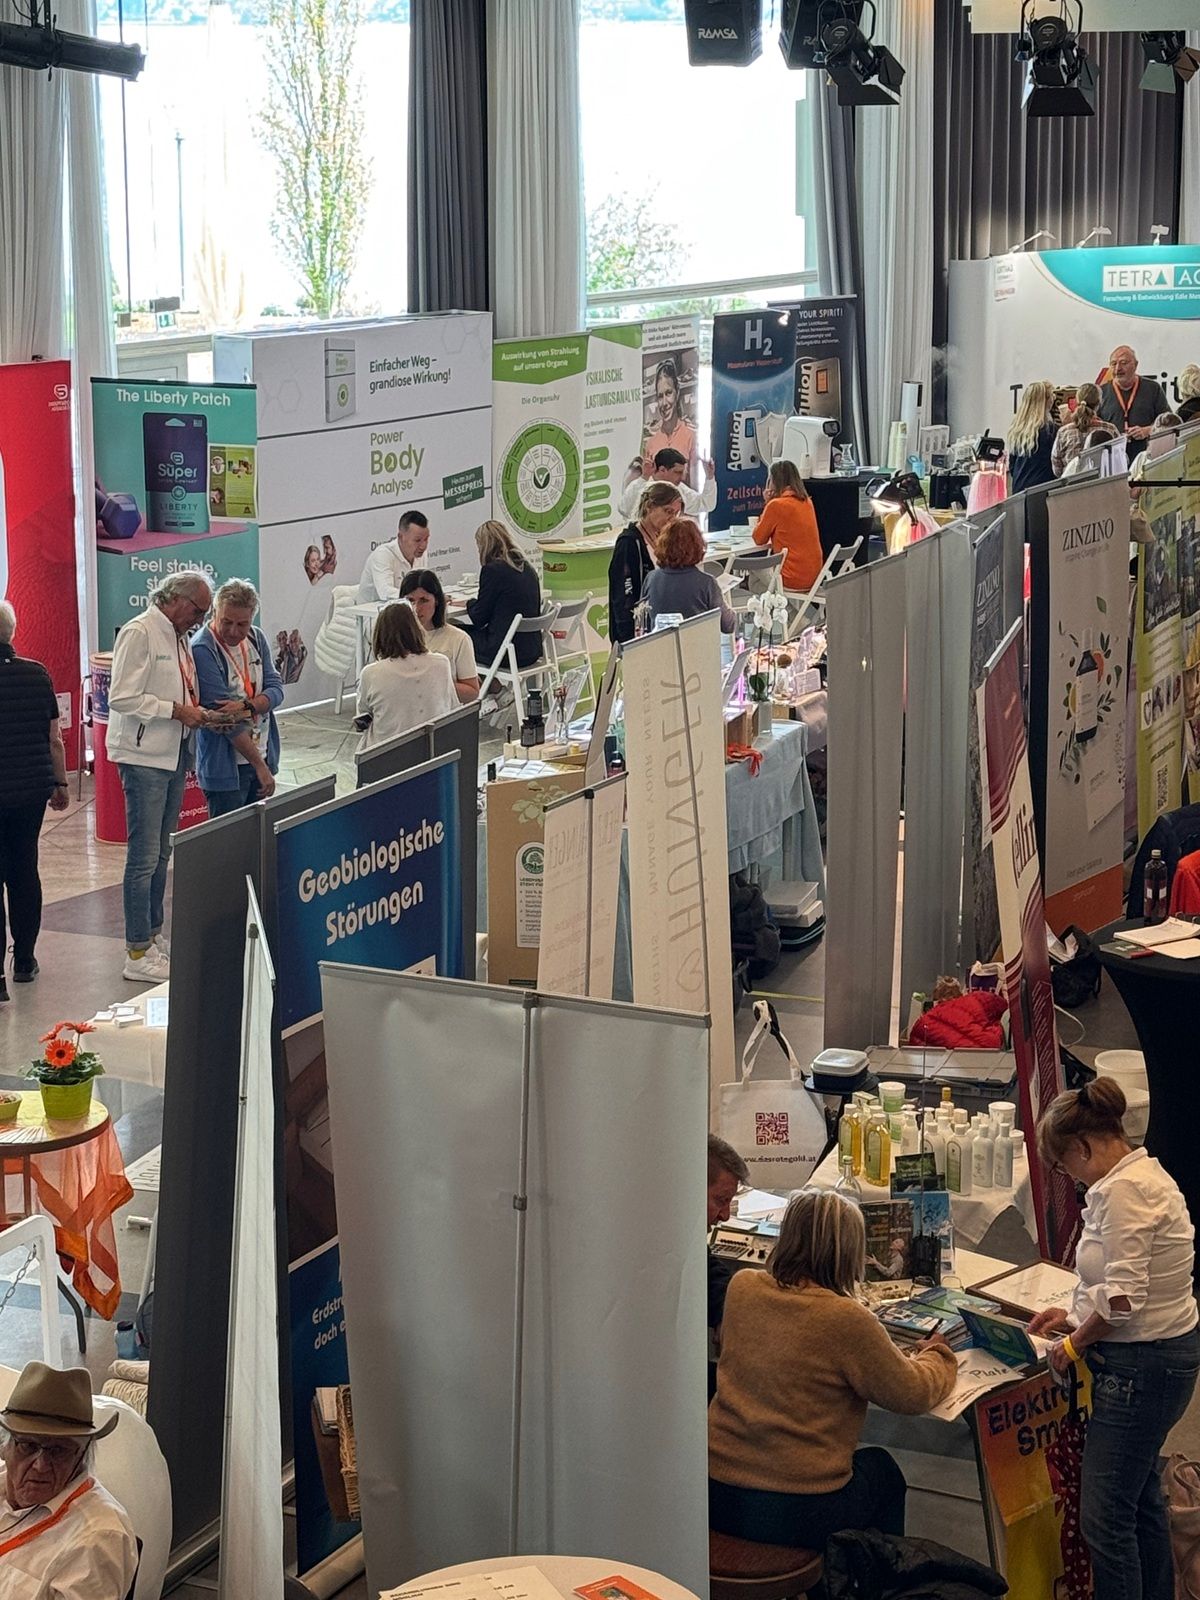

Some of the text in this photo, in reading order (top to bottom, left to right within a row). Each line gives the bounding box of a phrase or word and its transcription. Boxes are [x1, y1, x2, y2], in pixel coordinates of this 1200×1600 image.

[698, 28, 738, 39] RAMSA
[803, 36, 817, 45] RA
[1107, 269, 1168, 287] TETRA
[798, 310, 818, 319] YOUR
[537, 349, 550, 358] von
[550, 347, 580, 355] Strahlung
[369, 358, 410, 373] Einfacher
[410, 355, 430, 370] Weg
[513, 363, 524, 371] auf
[546, 360, 568, 369] Organe
[369, 368, 451, 394] grandiose Wirkung!
[117, 388, 231, 406] The Liberty Patch
[370, 431, 404, 446] Power
[727, 410, 742, 471] Aquion
[370, 443, 425, 477] Body
[370, 479, 414, 497] Analyse
[444, 479, 483, 499] MESSEPREIS
[727, 485, 763, 500] Zellsch
[160, 503, 198, 511] LIBERTY
[1062, 518, 1114, 552] ZINZINO
[130, 556, 163, 571] Feel
[129, 593, 152, 607] an
[298, 818, 445, 903] Geobiologische
[325, 881, 424, 946] Störungen
[314, 1322, 338, 1350] doch
[1017, 1419, 1060, 1457] Sm
